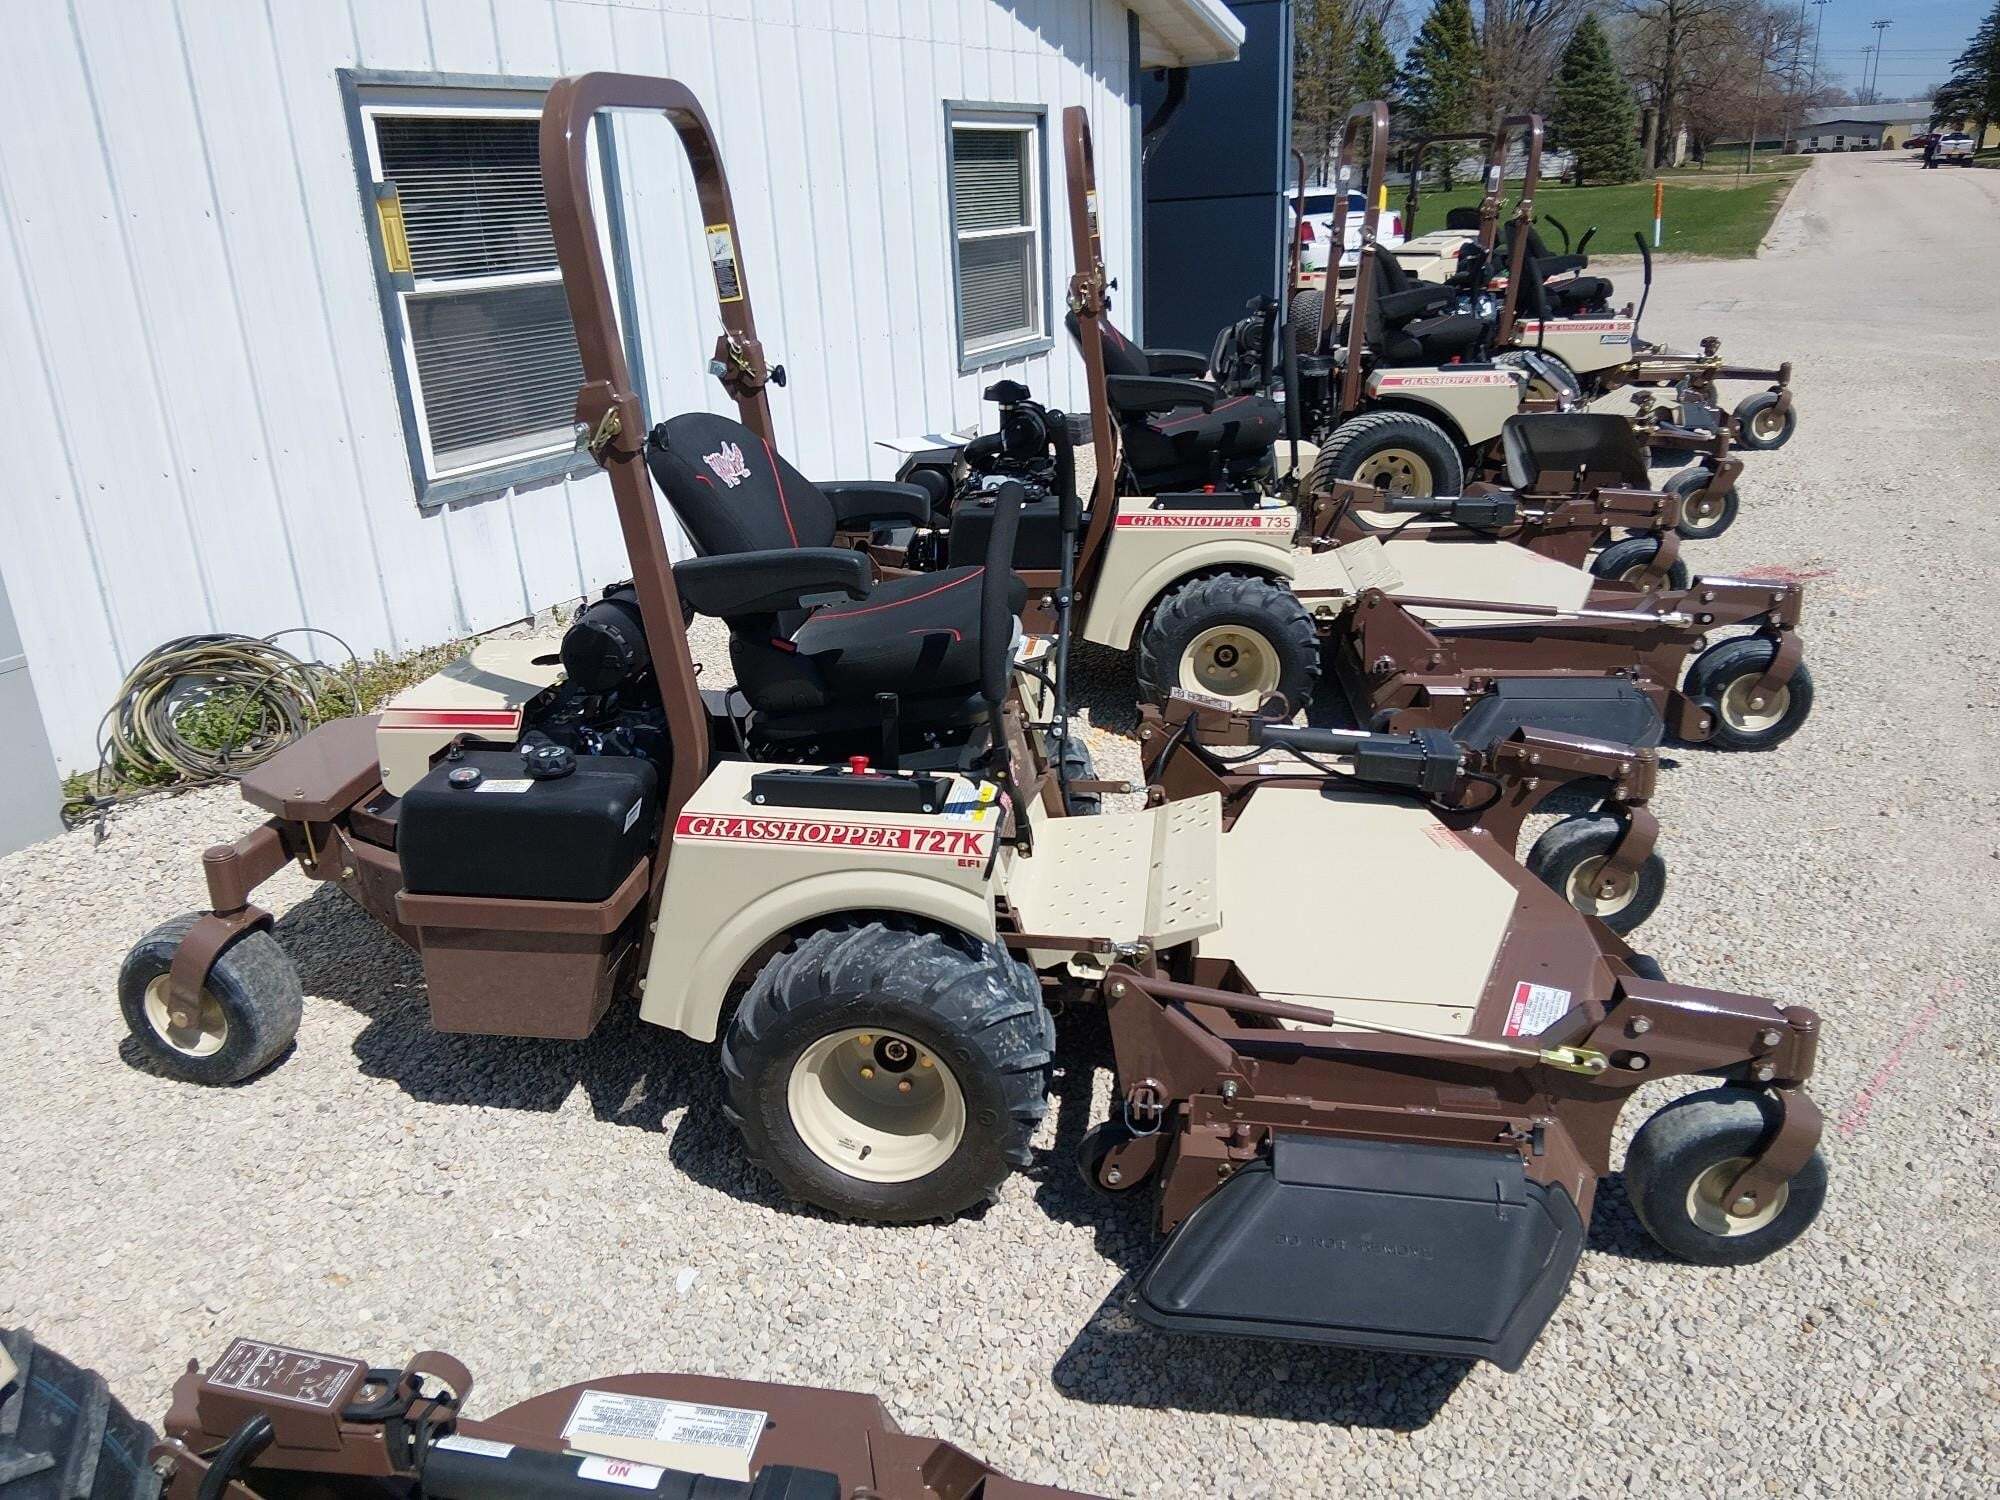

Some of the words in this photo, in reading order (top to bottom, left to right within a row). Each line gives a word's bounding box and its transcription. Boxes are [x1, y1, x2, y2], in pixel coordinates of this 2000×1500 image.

[1130, 516, 1253, 528] GRASSHOPPER
[1266, 517, 1291, 528] 735
[688, 815, 902, 848] GRASSHOPPER
[913, 828, 984, 856] 727K
[957, 858, 980, 869] EFI
